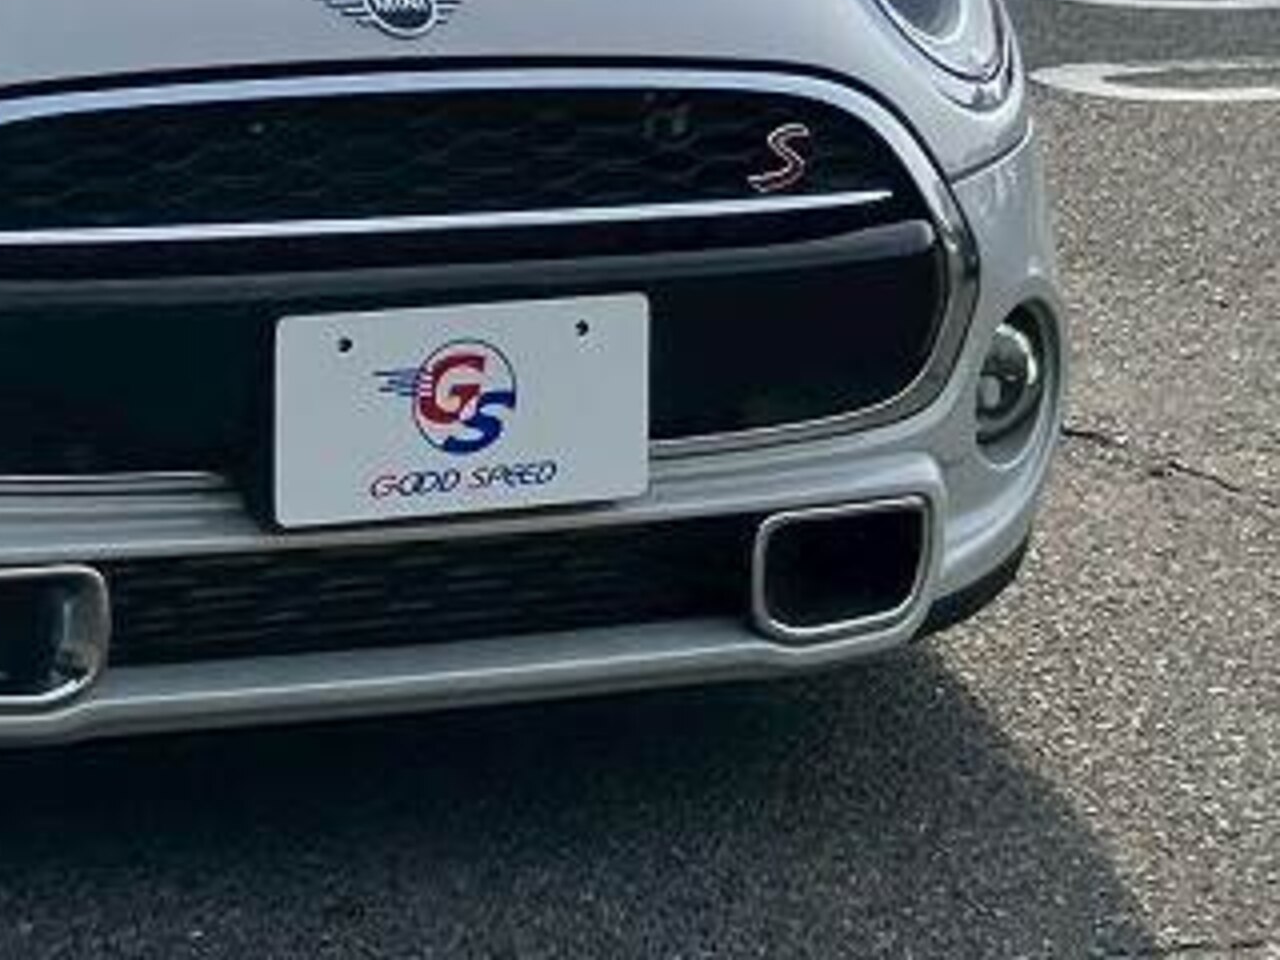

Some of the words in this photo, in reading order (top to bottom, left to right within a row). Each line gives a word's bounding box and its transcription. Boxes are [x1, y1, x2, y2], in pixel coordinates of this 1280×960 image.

[747, 123, 809, 192] S
[370, 468, 461, 498] GOOD
[468, 460, 558, 489] SPEED
